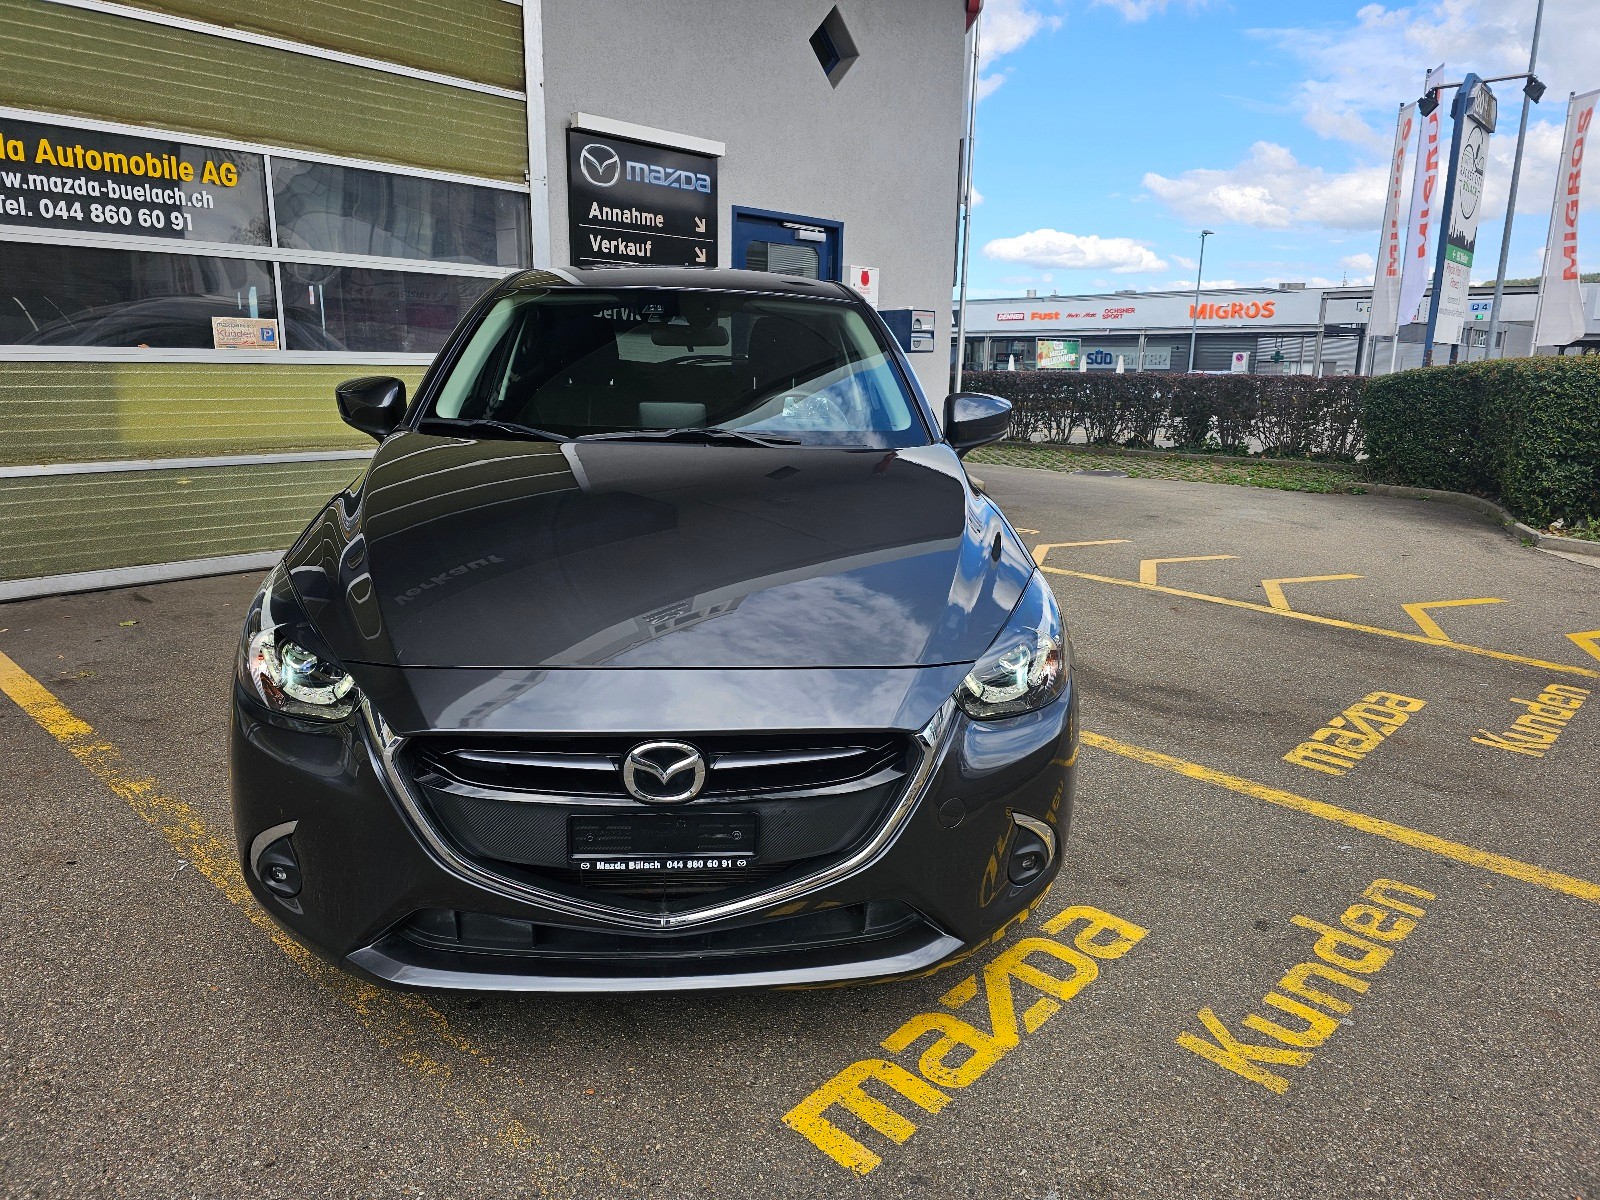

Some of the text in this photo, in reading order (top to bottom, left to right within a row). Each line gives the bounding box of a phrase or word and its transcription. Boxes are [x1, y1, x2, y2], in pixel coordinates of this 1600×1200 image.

[35, 138, 194, 182] Automobile
[202, 160, 238, 187] AG
[626, 160, 711, 193] mazda
[0, 171, 214, 209] w.mazda-buelach.ch
[1563, 106, 1594, 281] MIGROS
[39, 198, 84, 221] 044
[90, 203, 133, 226] 860
[138, 208, 165, 229] 60
[170, 211, 193, 231] 91
[588, 201, 664, 227] Annahme
[589, 234, 652, 257] Verkauf
[1030, 311, 1060, 320] Fust
[1189, 301, 1276, 319] MIGROS
[1086, 348, 1112, 365] SÜD
[1283, 691, 1427, 777] mazda
[1470, 683, 1591, 757] Kunden
[596, 861, 626, 870] Mazda
[666, 860, 683, 869] 044
[687, 860, 704, 869] 860
[707, 860, 719, 868] 60
[721, 859, 732, 868] 91
[1176, 878, 1437, 1095] Kunden
[782, 905, 1150, 1175] mazda
